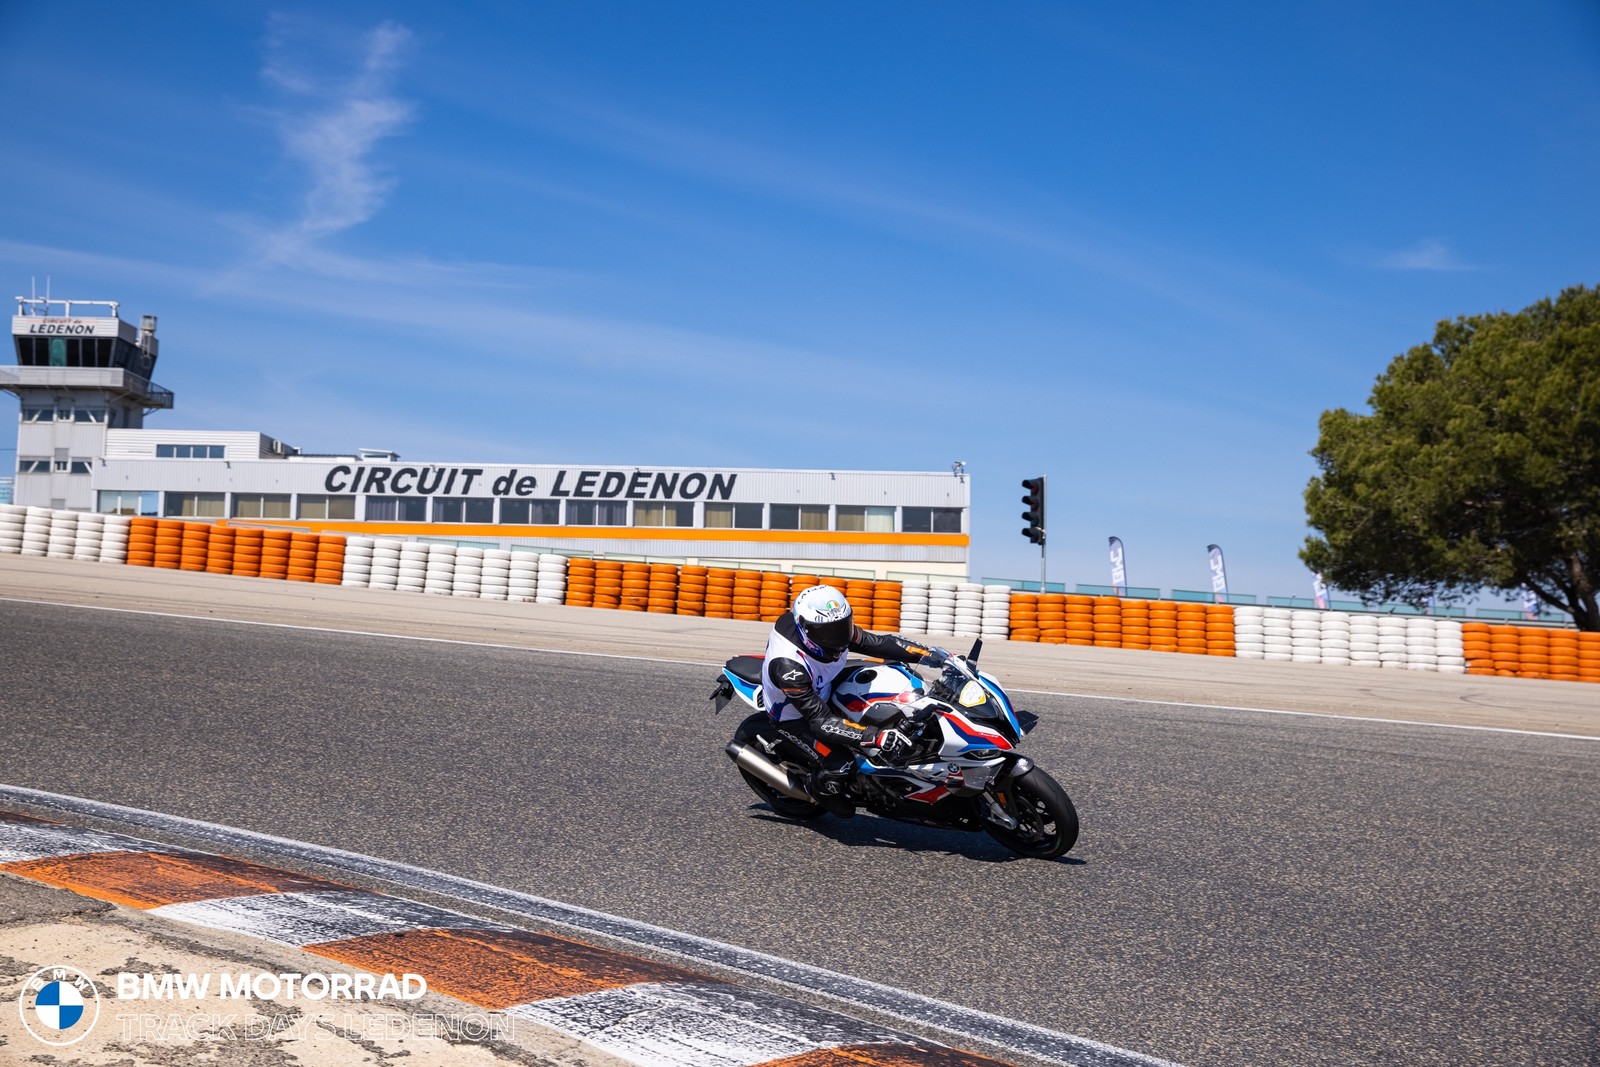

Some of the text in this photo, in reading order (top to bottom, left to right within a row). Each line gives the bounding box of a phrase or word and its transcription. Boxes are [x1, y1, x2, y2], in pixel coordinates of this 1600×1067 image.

[29, 324, 95, 335] LEDENON
[325, 465, 737, 500] CIRCUIT de LEDENON
